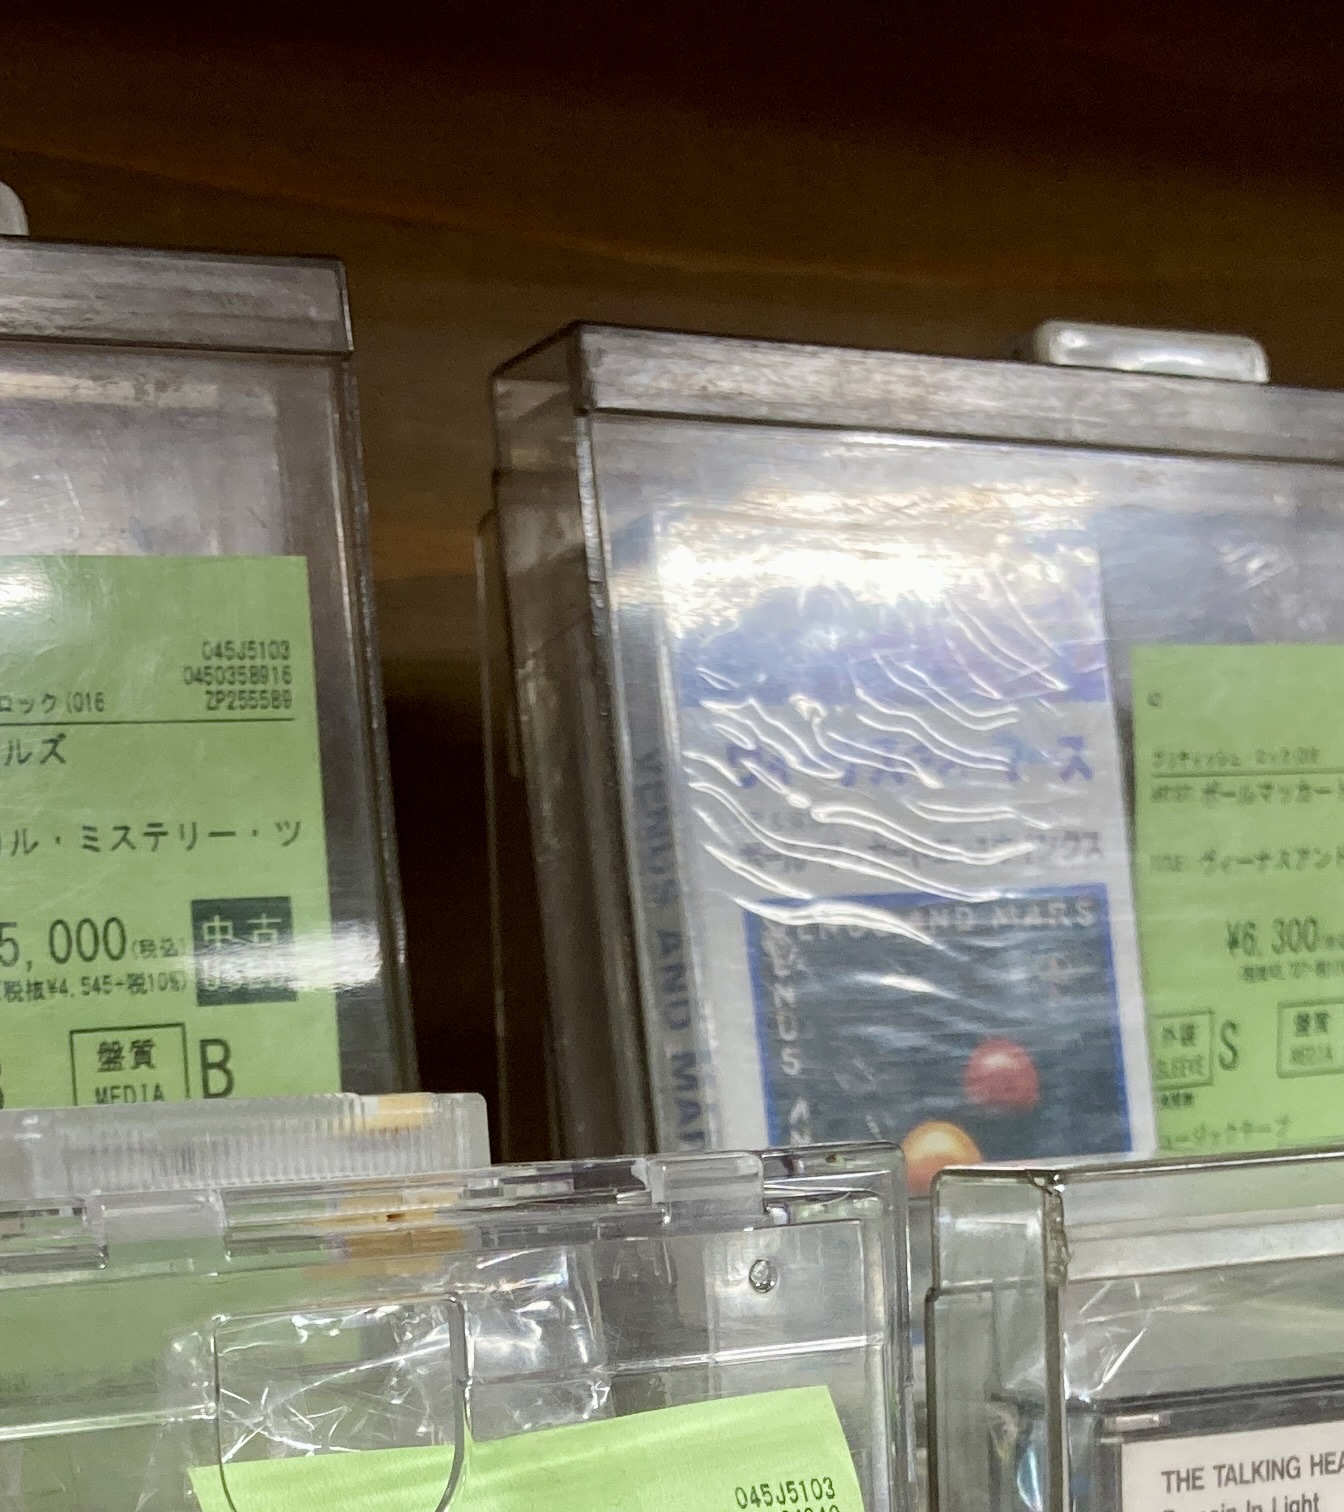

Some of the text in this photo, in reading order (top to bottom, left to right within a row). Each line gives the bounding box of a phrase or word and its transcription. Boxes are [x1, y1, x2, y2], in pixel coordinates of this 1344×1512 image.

[1218, 1018, 1241, 1071] S
[199, 1038, 235, 1100] B
[93, 1083, 167, 1105] MEDIA
[734, 1476, 836, 1509] 045J5103
[1162, 1467, 1205, 1494] THE
[1213, 1456, 1301, 1490] TALKING
